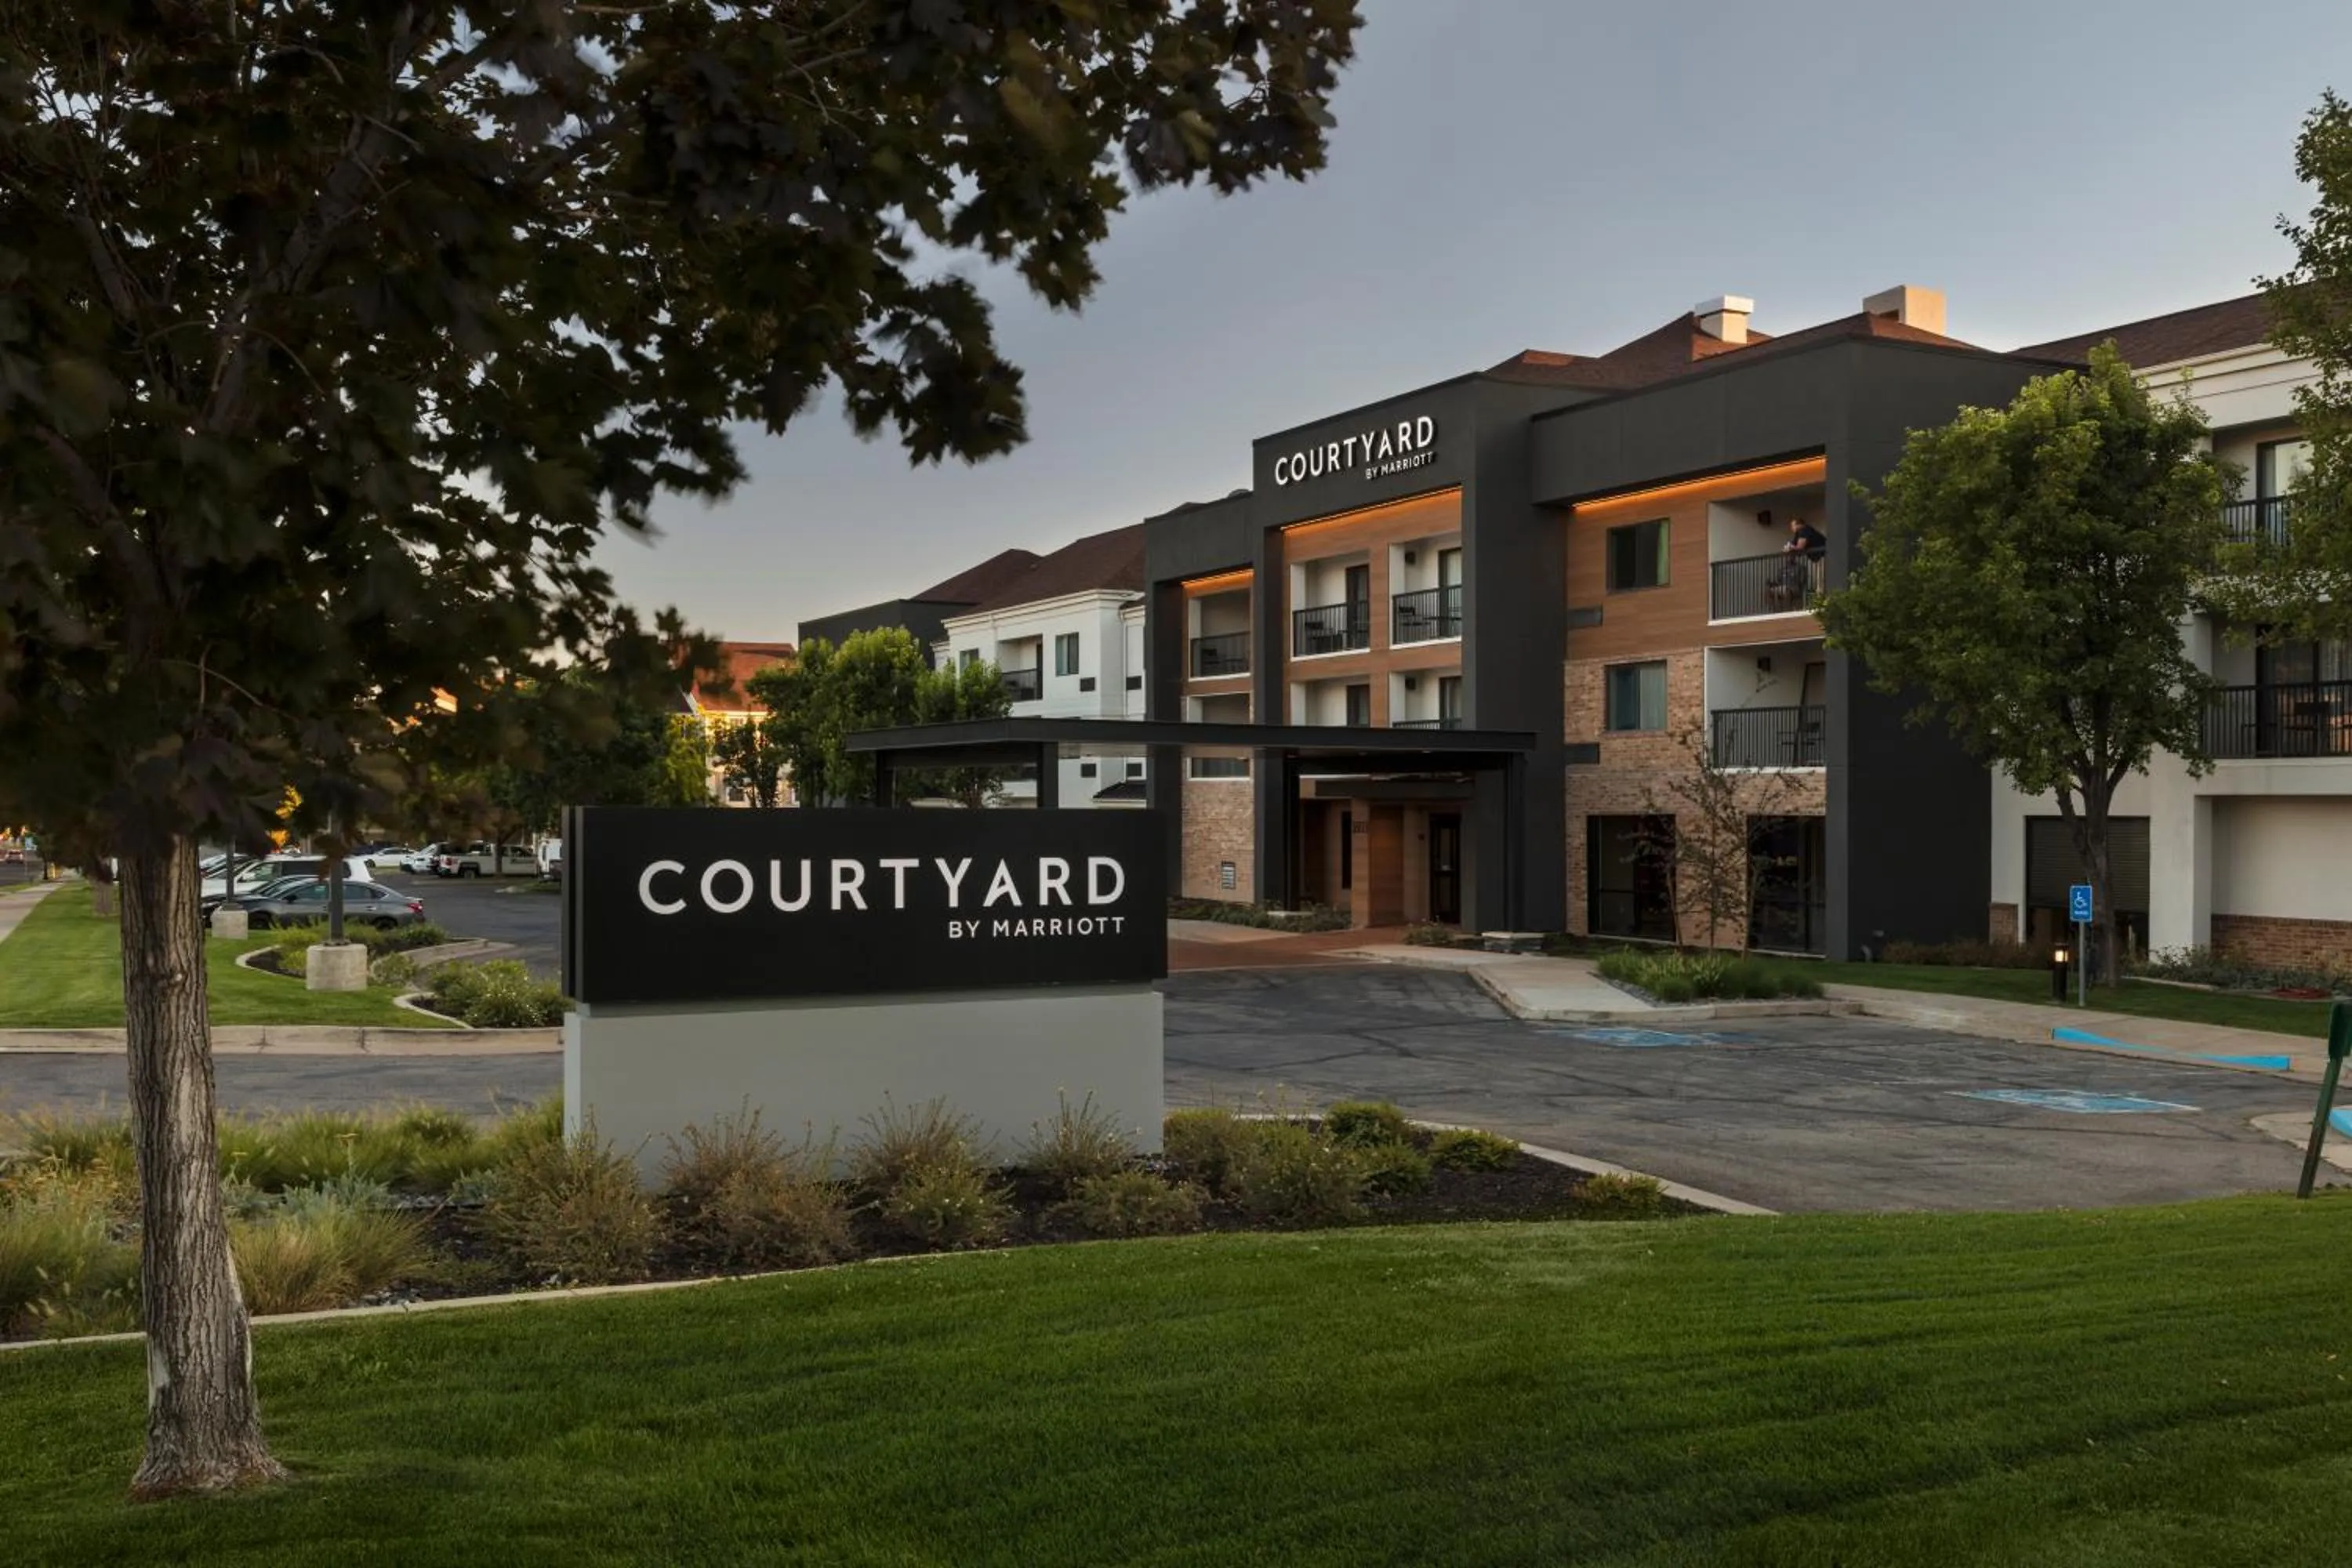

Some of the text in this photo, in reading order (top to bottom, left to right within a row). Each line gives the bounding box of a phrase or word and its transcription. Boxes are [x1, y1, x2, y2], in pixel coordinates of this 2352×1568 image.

[1274, 416, 1434, 486] COURTYARD
[1365, 451, 1433, 480] BY MARRIOTT
[638, 856, 1126, 915] COURTYARD
[949, 916, 1125, 938] BY MARRIOTT
